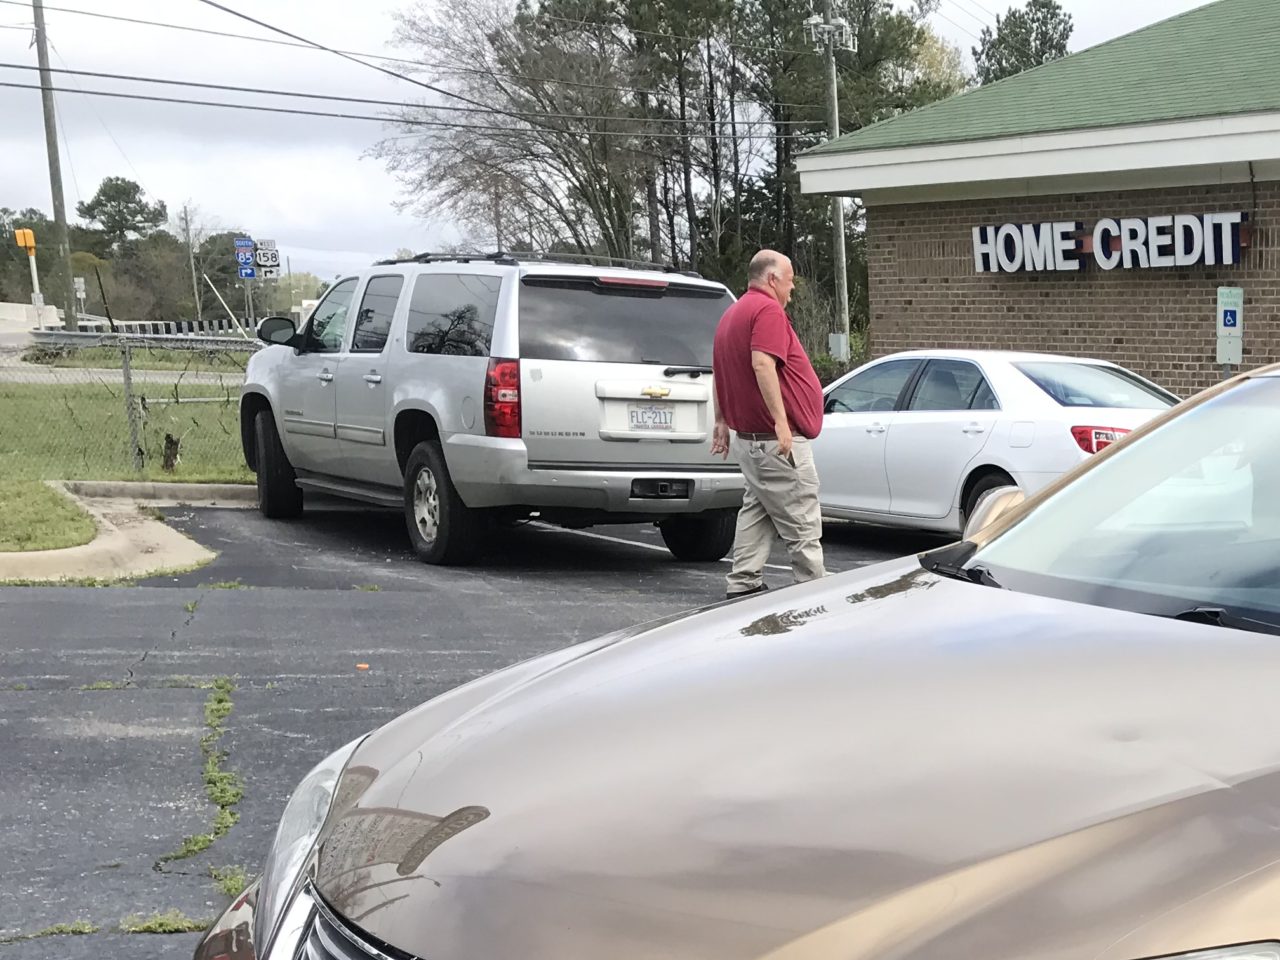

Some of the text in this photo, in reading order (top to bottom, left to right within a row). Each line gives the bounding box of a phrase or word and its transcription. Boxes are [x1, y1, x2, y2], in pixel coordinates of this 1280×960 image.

[972, 212, 1244, 273] HOME CREDIT
[238, 252, 253, 262] 85
[258, 252, 278, 262] 158
[630, 410, 673, 425] FLC-2117
